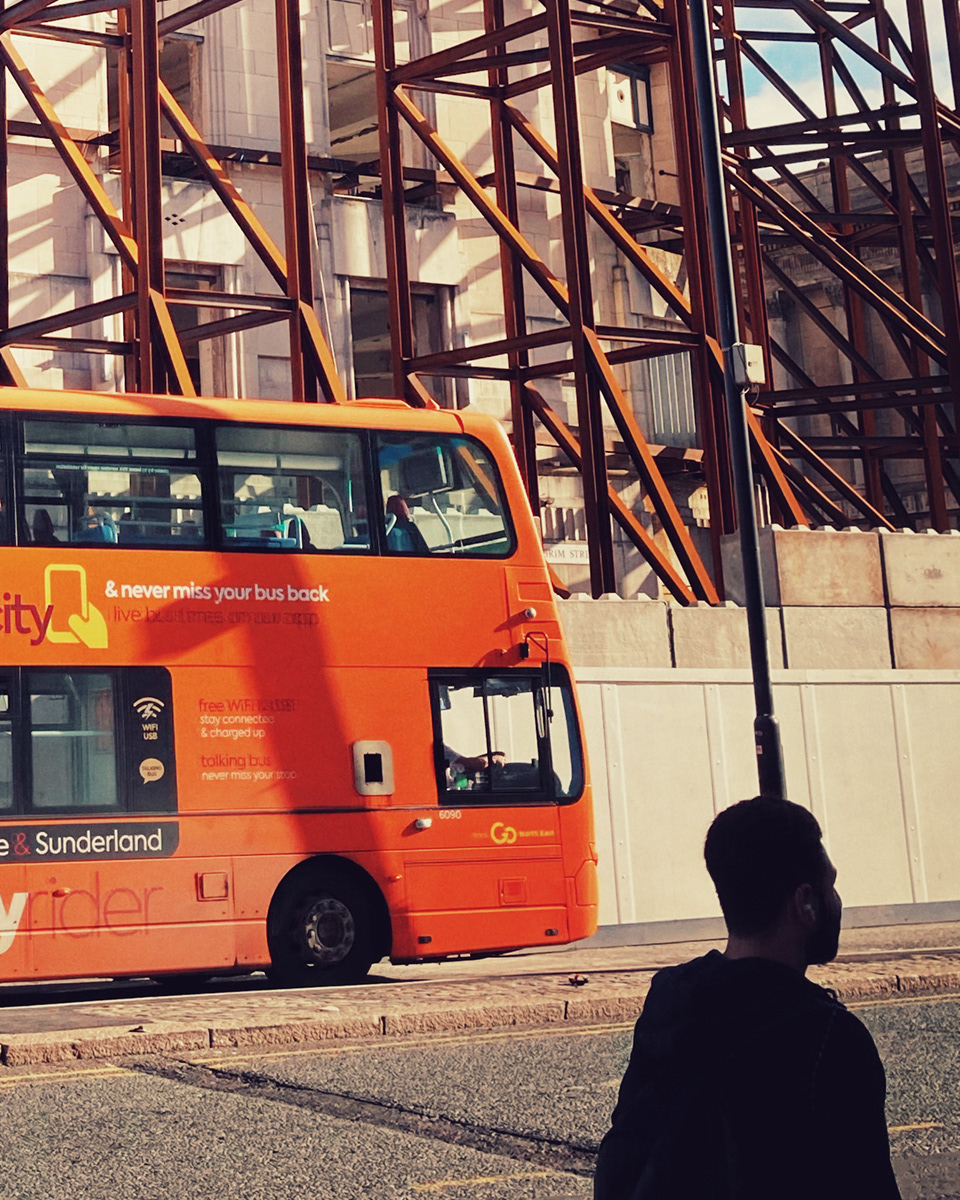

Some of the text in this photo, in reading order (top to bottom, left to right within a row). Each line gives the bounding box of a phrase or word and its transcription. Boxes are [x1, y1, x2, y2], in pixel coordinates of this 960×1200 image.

[105, 580, 329, 604] & never miss your bus back
[113, 606, 141, 623] live
[199, 699, 224, 712] free
[200, 715, 220, 726] stay
[142, 723, 158, 731] WIFI
[143, 732, 158, 740] USB
[201, 728, 265, 740] & charged up
[201, 754, 272, 770] talking bus
[202, 771, 229, 780] never
[231, 770, 251, 780] miss
[253, 771, 273, 781] your
[439, 810, 462, 819] 6090
[12, 832, 30, 856] &
[36, 828, 162, 855] Sunderland
